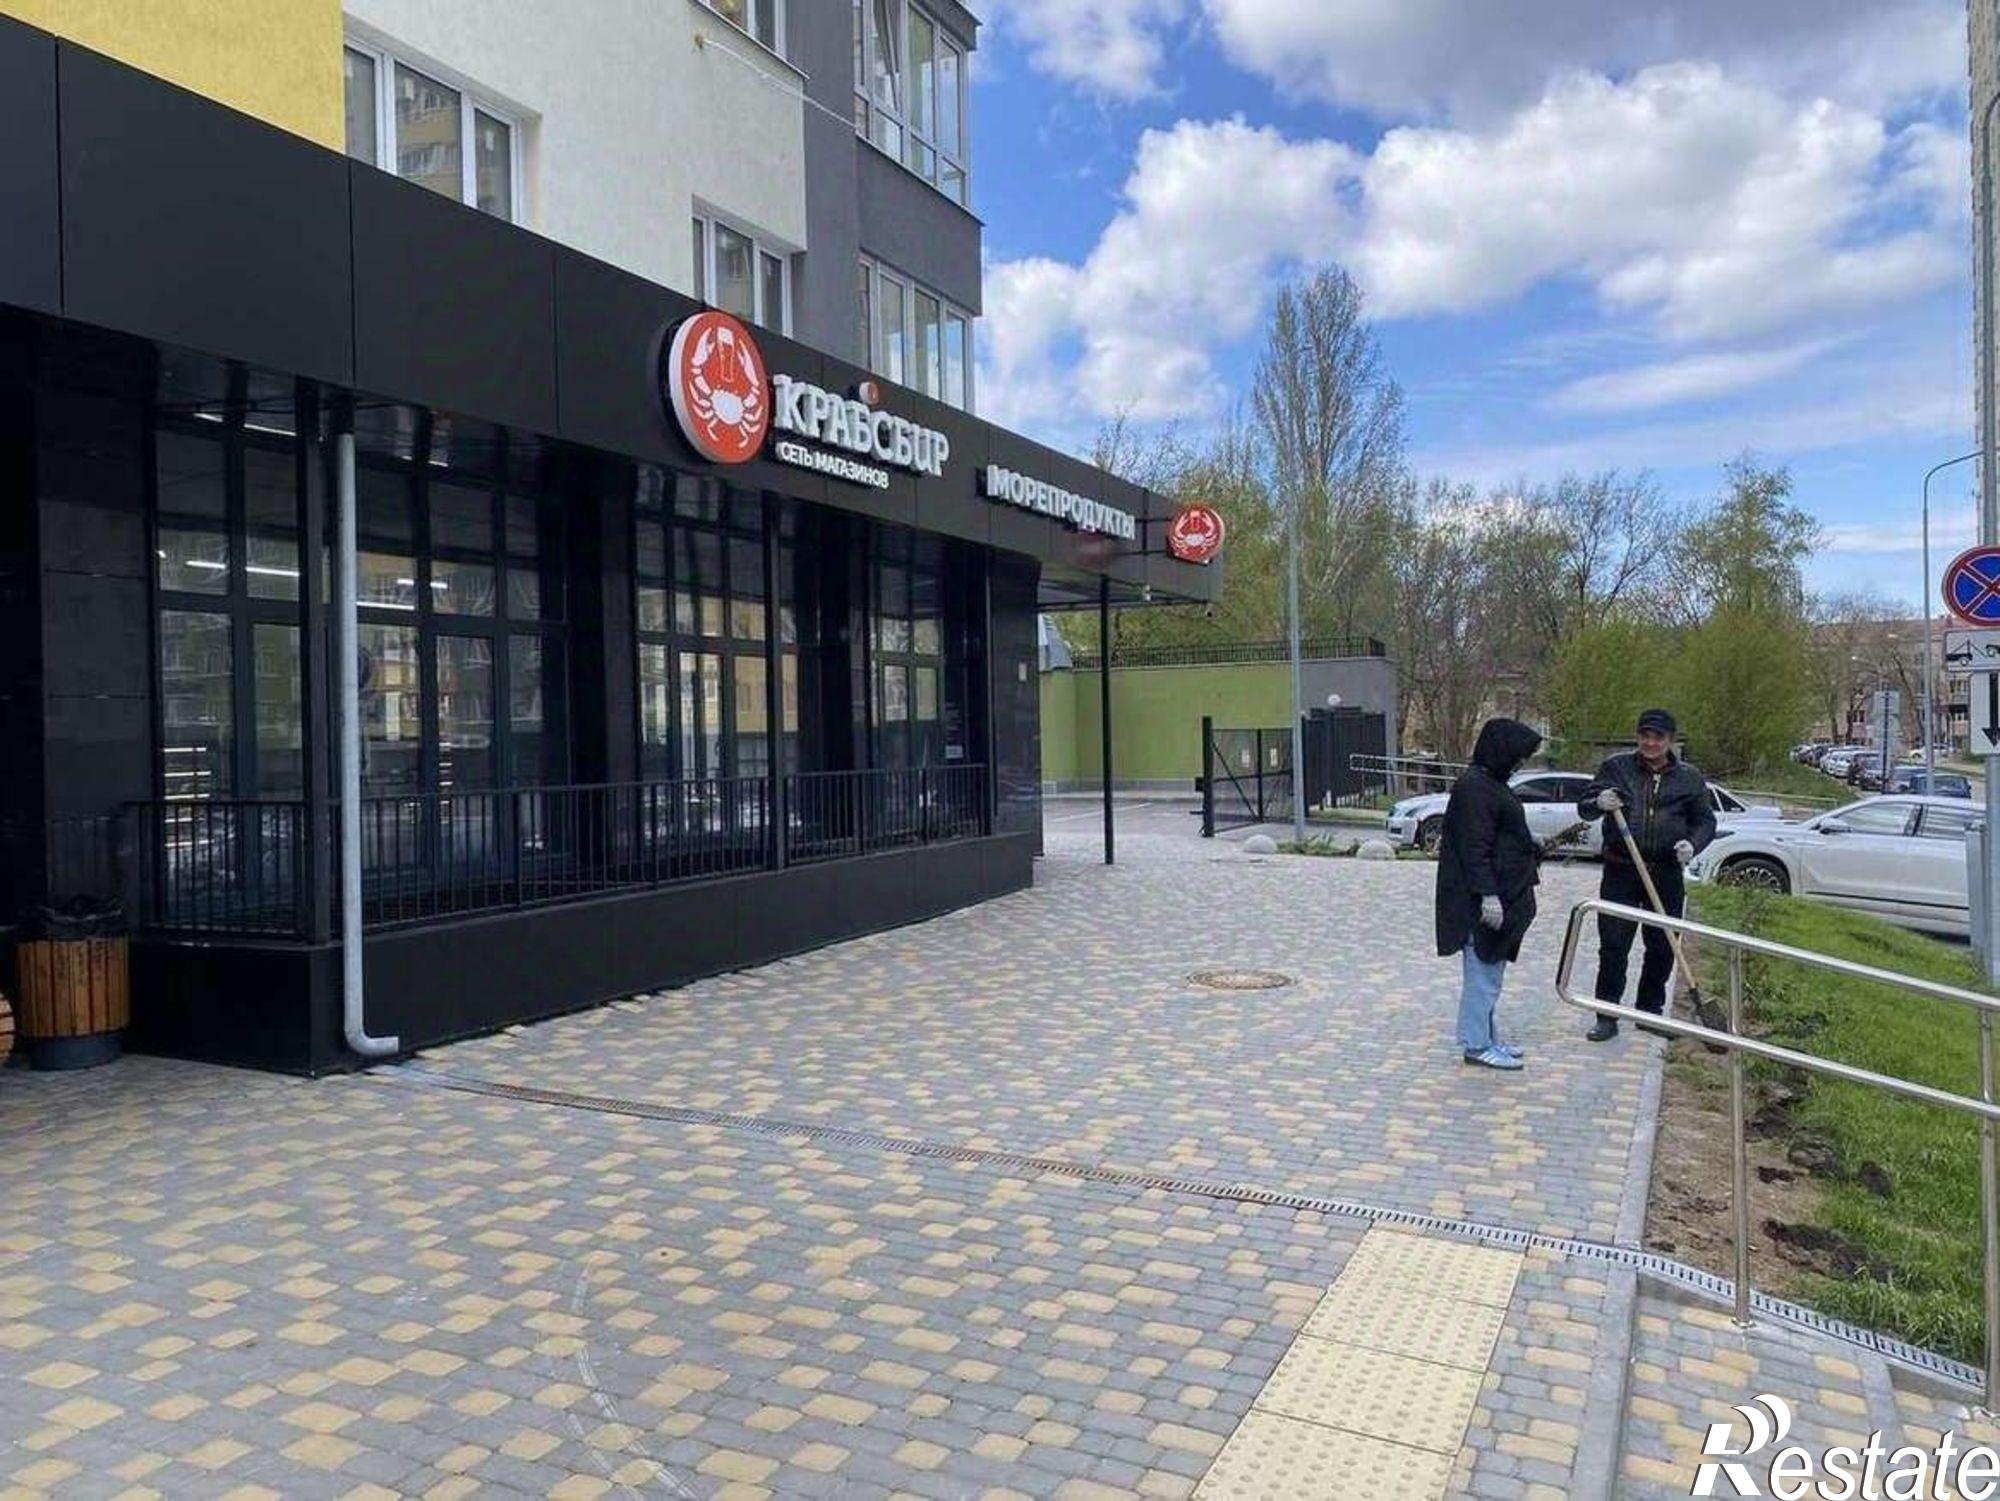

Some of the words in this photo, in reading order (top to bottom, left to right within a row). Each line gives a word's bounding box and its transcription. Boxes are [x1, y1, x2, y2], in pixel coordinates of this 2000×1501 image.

[776, 441, 813, 468] СЕТЬ
[814, 451, 889, 490] МАГАЗИНОВ
[986, 464, 1136, 541] МОРЕПРОДУКТЫ
